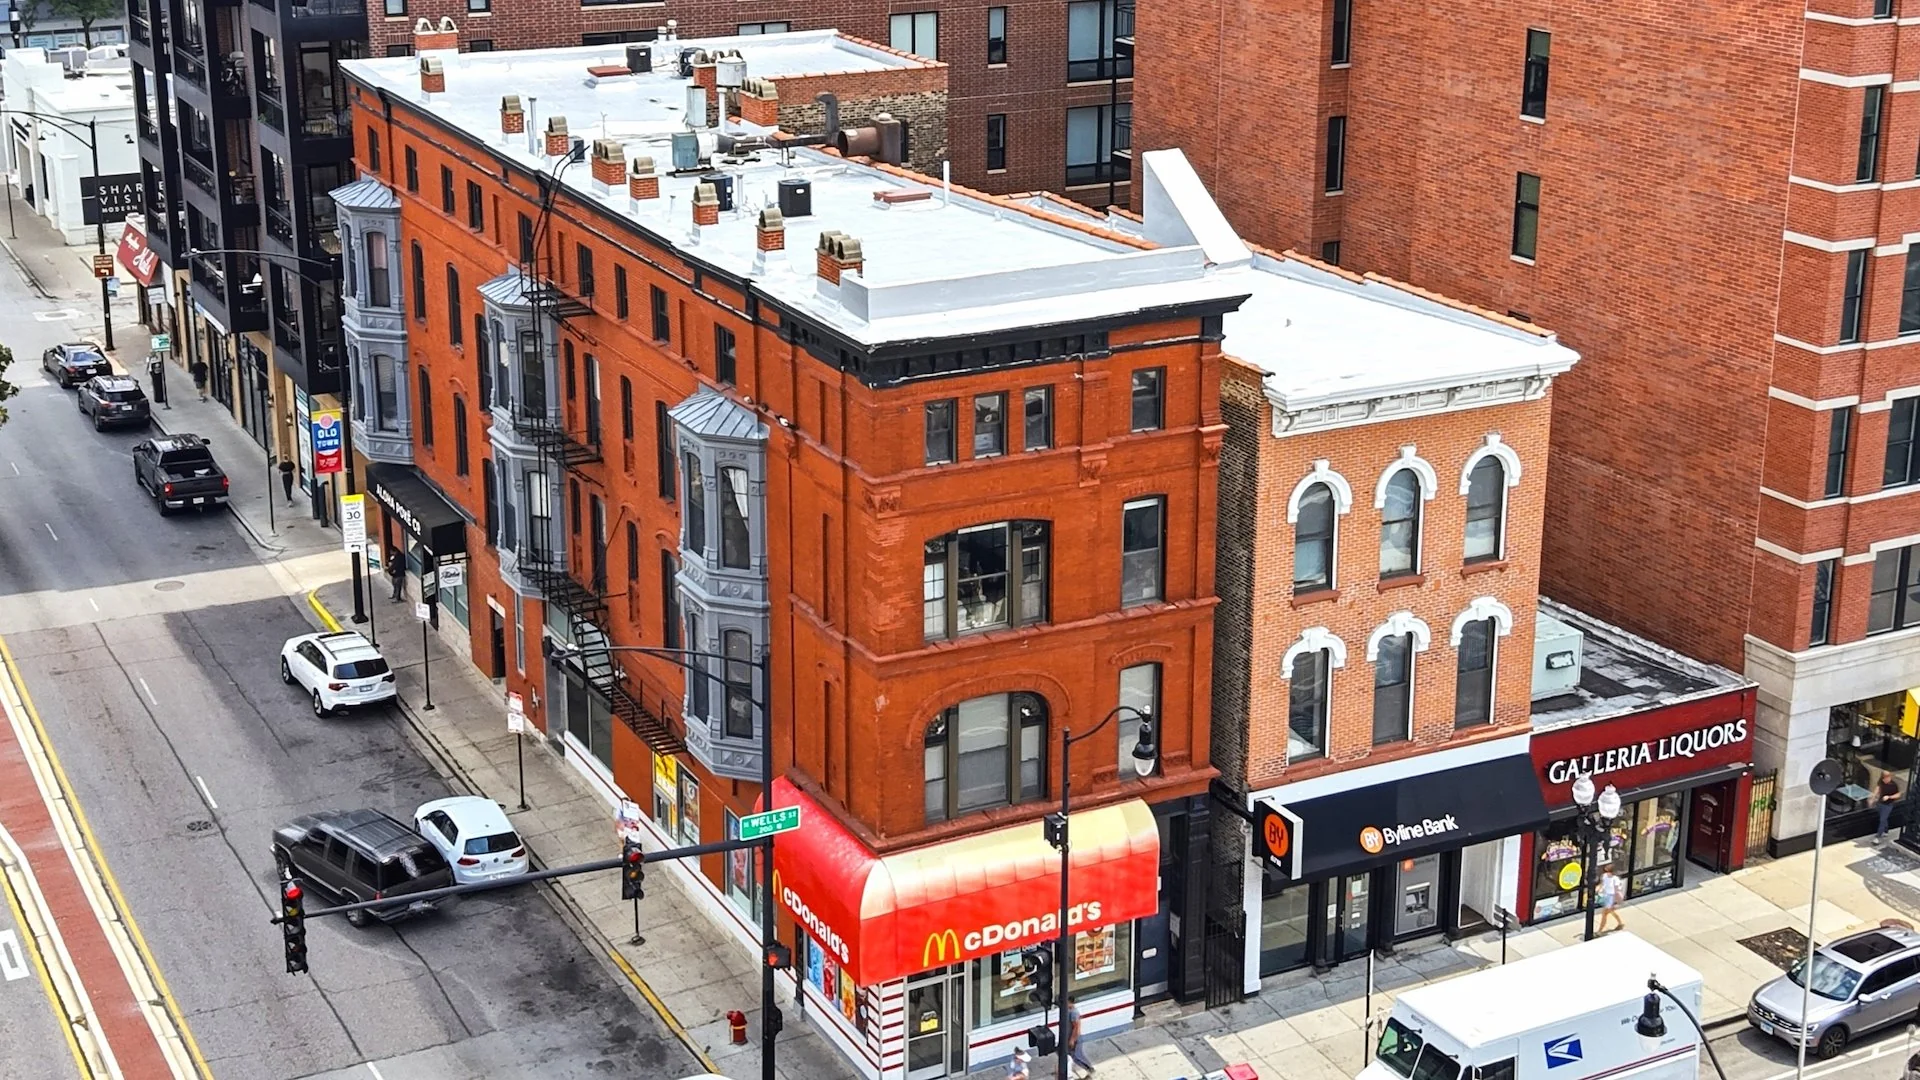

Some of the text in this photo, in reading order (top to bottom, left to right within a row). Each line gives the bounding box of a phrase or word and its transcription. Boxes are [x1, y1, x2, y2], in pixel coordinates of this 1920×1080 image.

[317, 427, 338, 439] OLD
[316, 439, 340, 449] TOWN
[346, 510, 361, 520] 30
[1549, 719, 1747, 784] GALLERIA LIQUORS
[750, 812, 787, 828] WELLS
[1269, 821, 1284, 849] BY
[1382, 814, 1459, 846] Byline Bank
[1364, 831, 1379, 849] BY
